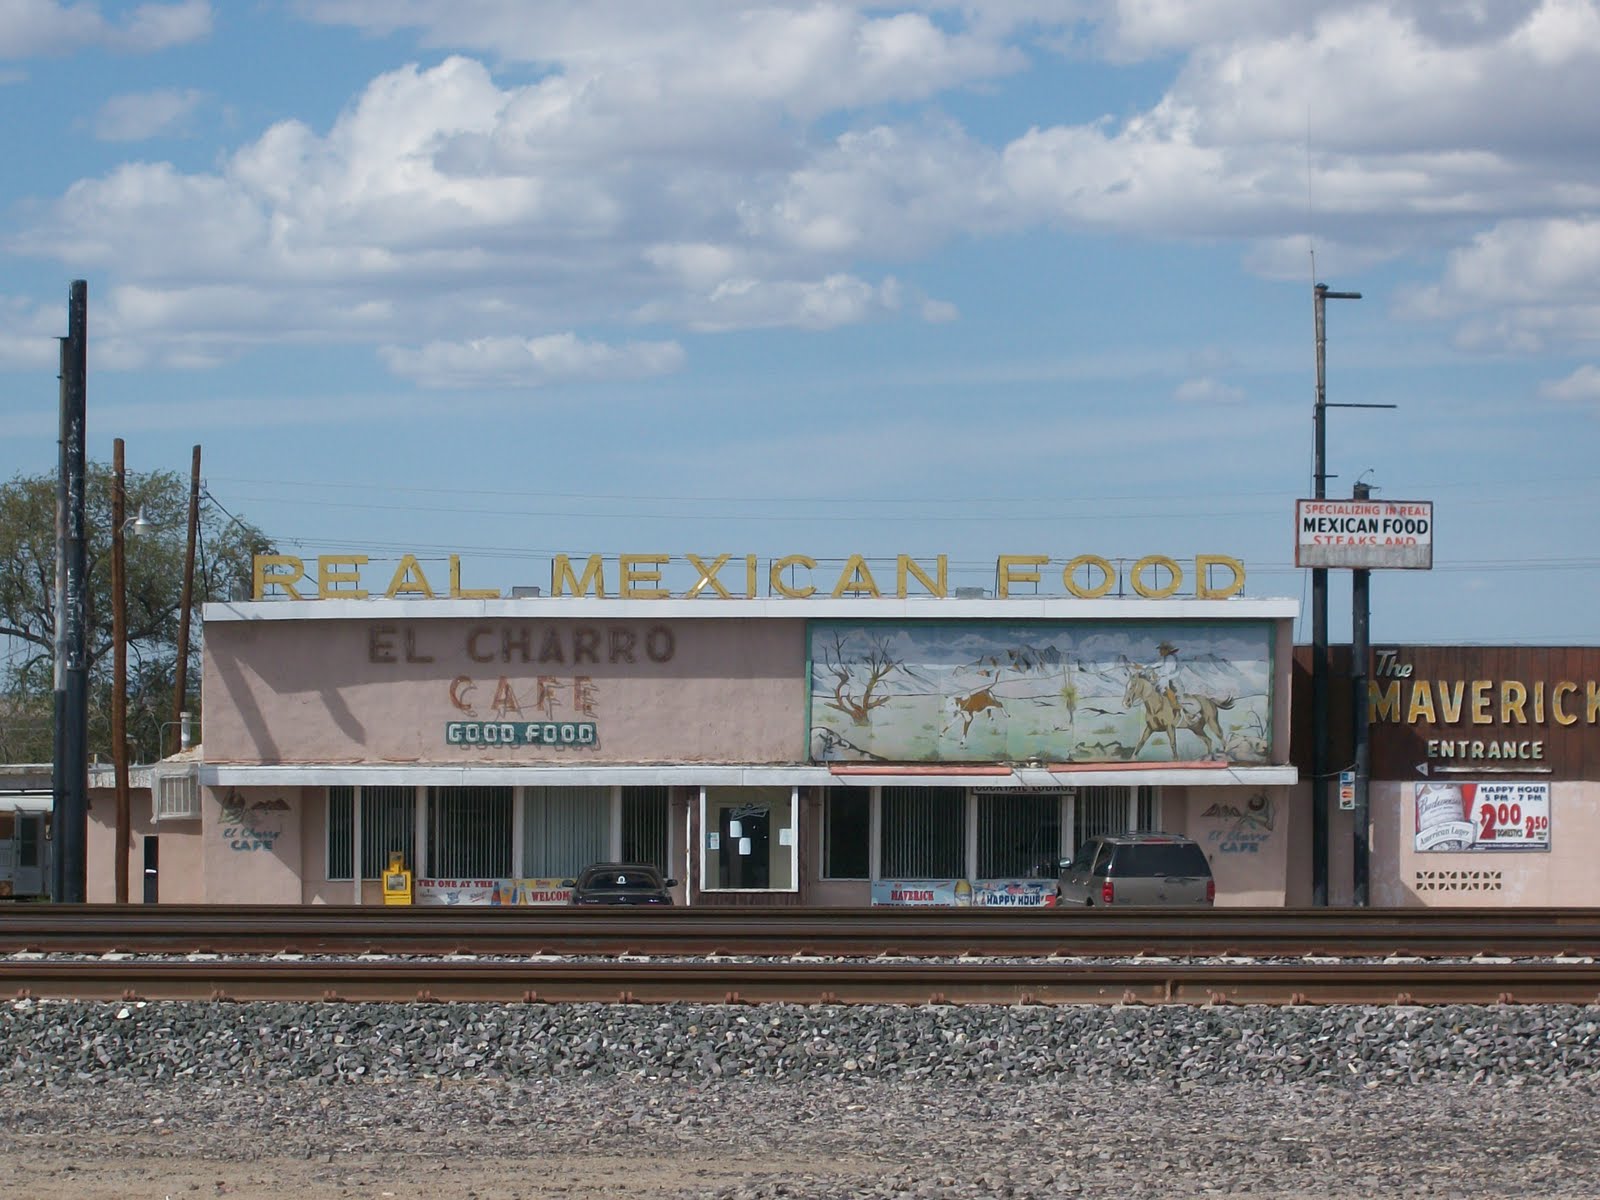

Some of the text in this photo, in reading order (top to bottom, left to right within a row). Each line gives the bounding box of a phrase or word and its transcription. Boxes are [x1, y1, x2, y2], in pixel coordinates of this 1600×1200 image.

[1305, 504, 1428, 516] SPECIALIZING IN REAL
[1303, 517, 1428, 534] MEXICAN FOOD
[1313, 535, 1417, 545] STEAKS AND
[253, 554, 1246, 600] REAL MEXICAN FOOD
[368, 624, 676, 665] EL CHARRO
[1376, 650, 1413, 678] The
[449, 675, 597, 714] CAFE
[448, 723, 594, 743] GOOD FOOD
[1427, 740, 1544, 759] ENTRANCE
[231, 840, 273, 852] CAFE
[438, 880, 457, 888] ONE
[531, 891, 571, 902] WELCOM
[891, 890, 934, 901] MAVERICK
[987, 895, 1015, 905] HAPPY
[1018, 895, 1041, 905] HOUR
